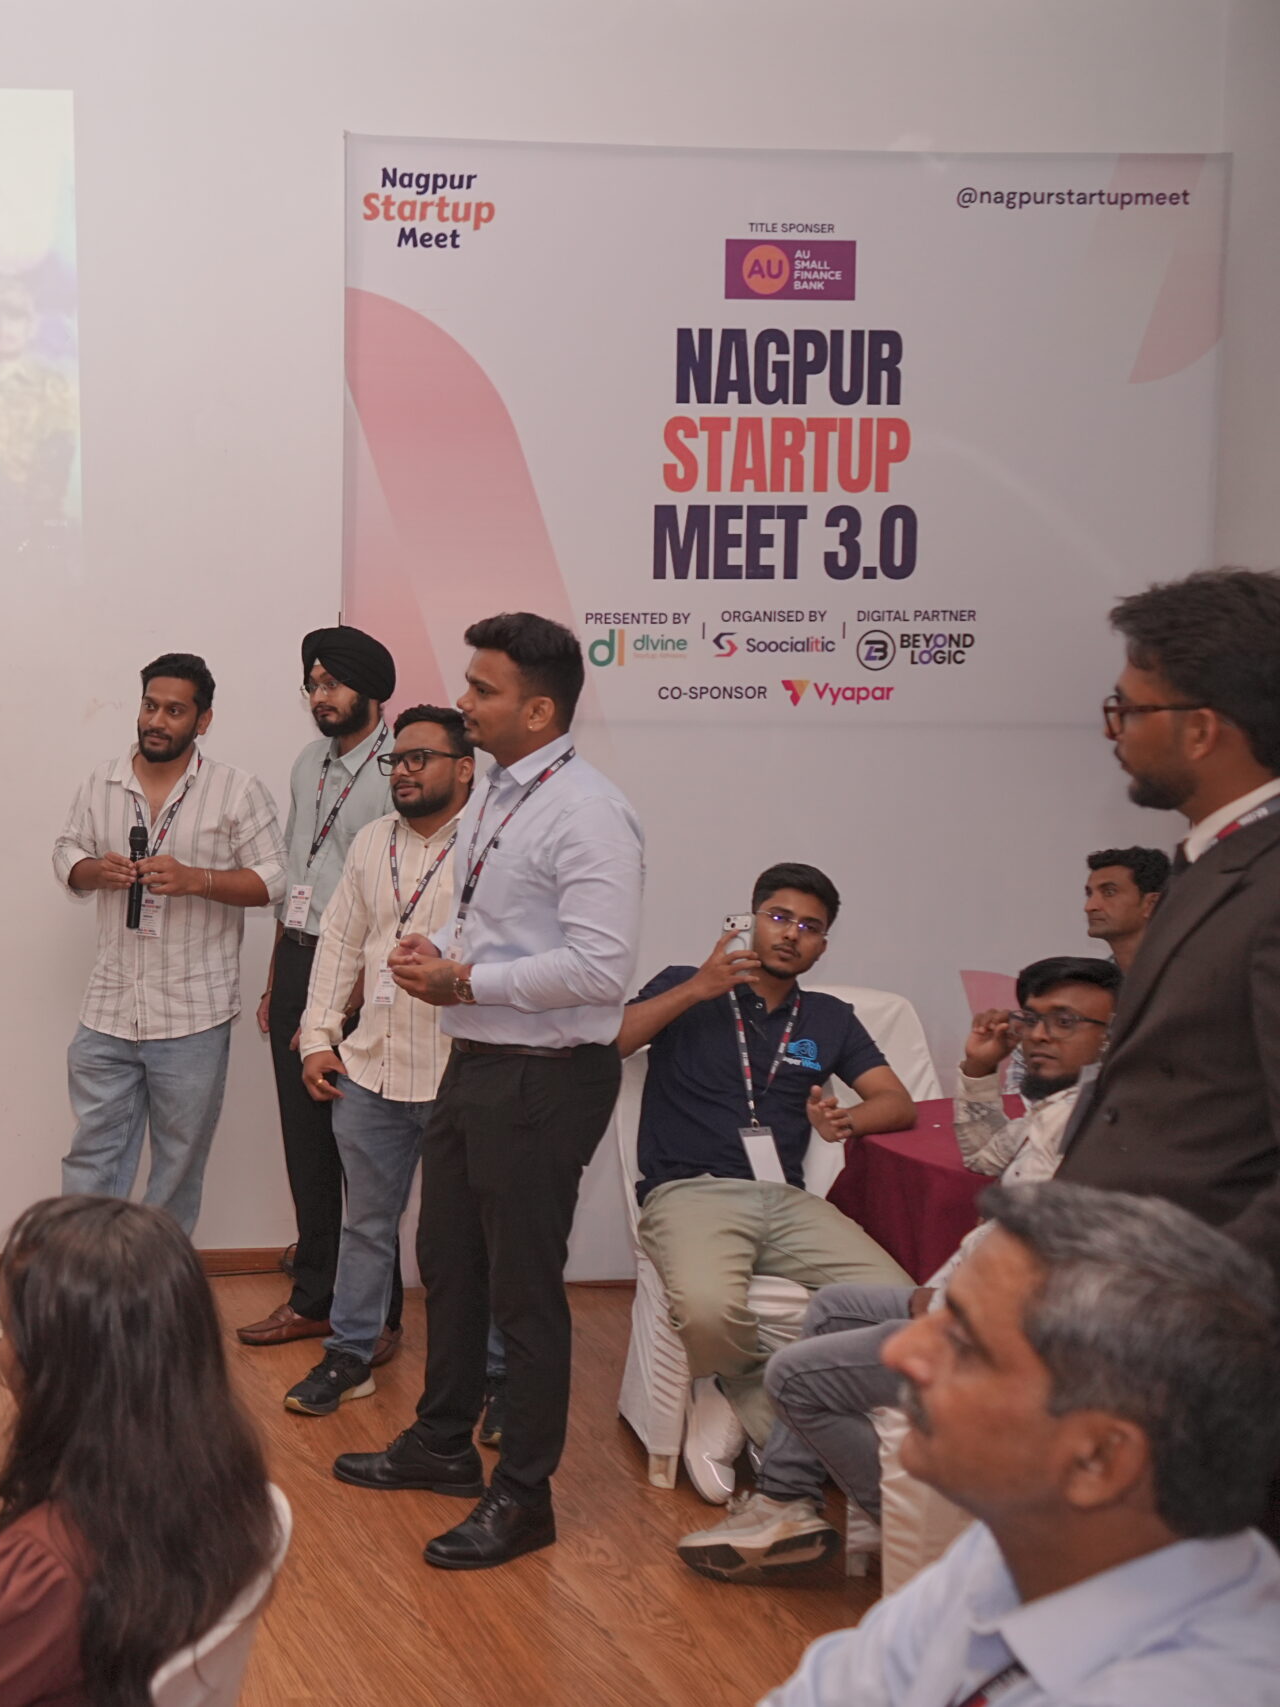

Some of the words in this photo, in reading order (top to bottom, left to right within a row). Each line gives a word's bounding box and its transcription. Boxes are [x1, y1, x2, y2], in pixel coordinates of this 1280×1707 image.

[381, 167, 477, 195] Nagpur
[956, 187, 1190, 210] @nagpurstartupmeet
[363, 192, 496, 231] Startup
[748, 222, 778, 233] TITLE
[781, 223, 835, 234] SPONSER
[397, 227, 461, 249] Meet
[794, 250, 811, 259] AU
[747, 258, 783, 280] AU
[794, 260, 831, 270] SMALL
[793, 271, 842, 280] FINANCE
[793, 281, 825, 290] BANK
[676, 327, 903, 405] NAGPUR
[662, 416, 911, 493] STARTUP
[653, 504, 808, 580] MEET
[823, 504, 918, 580] 3.0
[585, 612, 668, 625] PRESENTED
[672, 612, 691, 624] BY
[721, 610, 805, 622] ORGANISED
[808, 610, 827, 622] BY
[857, 610, 909, 622] DIGITAL
[913, 610, 977, 622] PARTNER
[746, 636, 836, 653] Soocialitic
[899, 633, 975, 649] BEYOND
[910, 649, 966, 665] LOGIC
[658, 686, 767, 700] CO-SPONSOR
[814, 682, 894, 705] Vyapar
